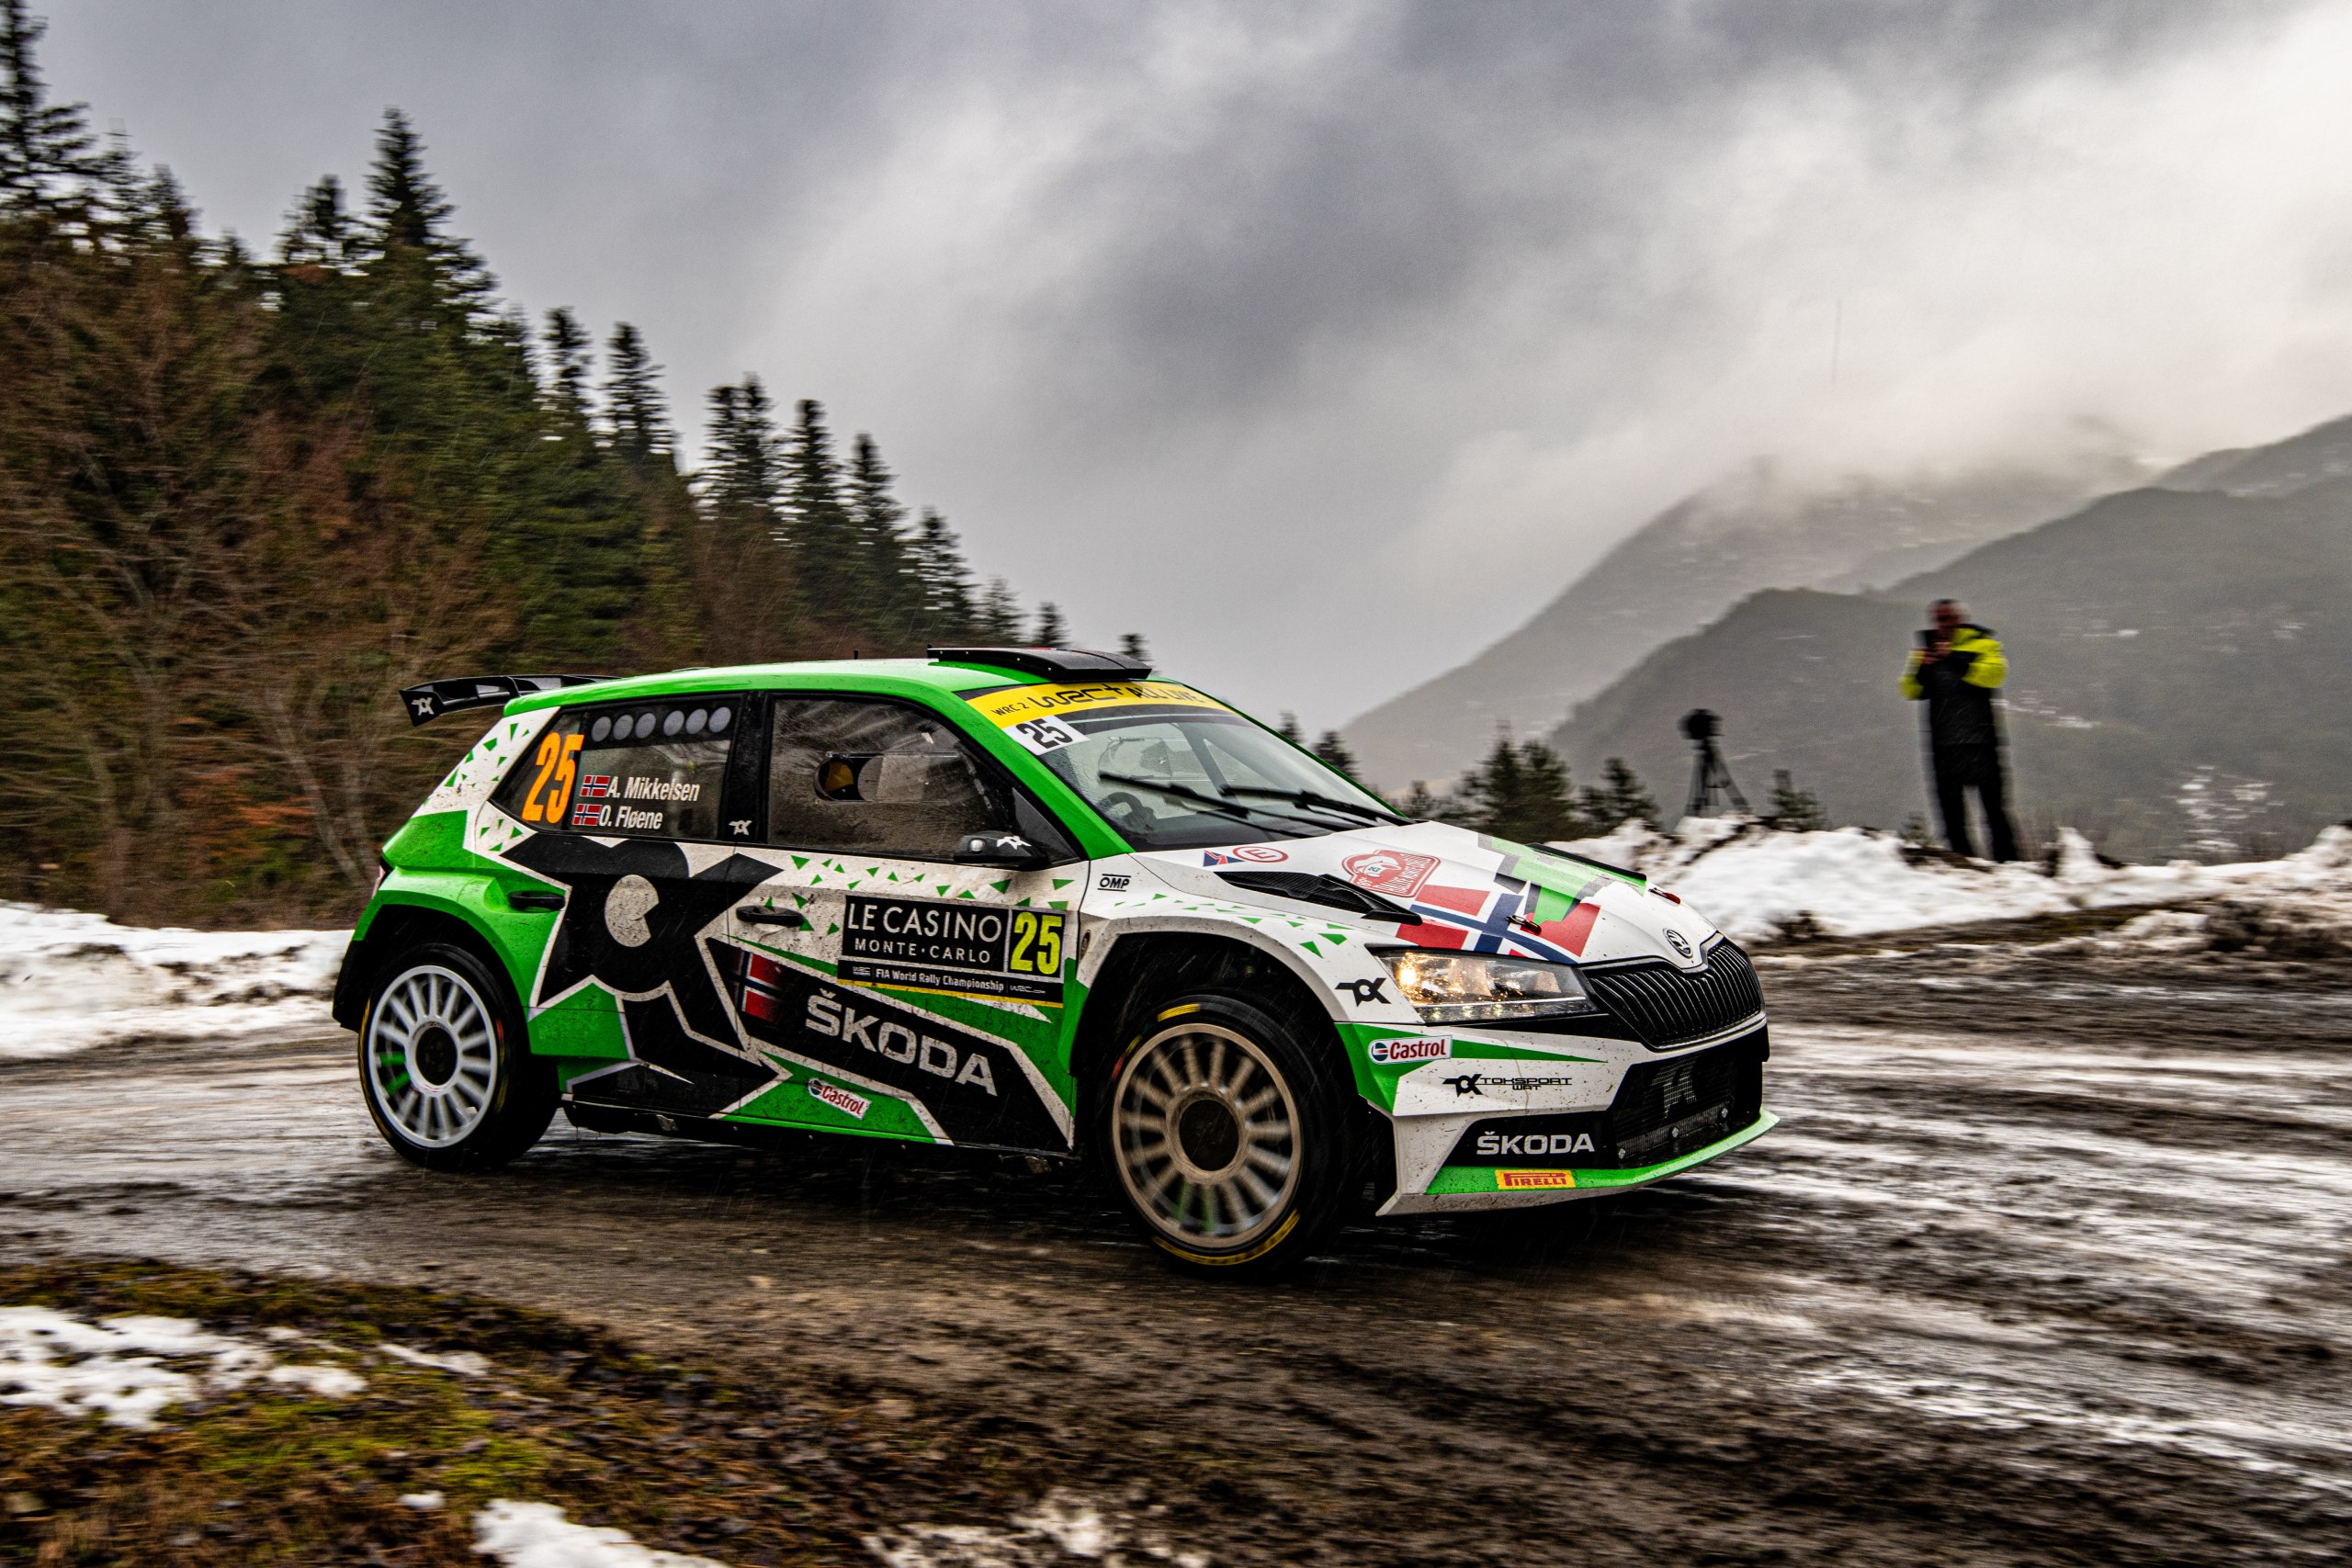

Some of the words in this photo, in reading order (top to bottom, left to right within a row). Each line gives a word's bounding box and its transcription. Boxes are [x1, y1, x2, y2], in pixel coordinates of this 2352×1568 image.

[992, 705, 1020, 716] WRC
[1015, 717, 1074, 750] 25
[521, 731, 585, 824] 25
[606, 775, 621, 797] A.
[625, 776, 701, 802] Mikkelsen
[598, 804, 613, 827] O.
[615, 806, 663, 829] Fløene
[1100, 876, 1130, 889] OMP
[847, 903, 877, 931] LE
[882, 907, 1002, 942] CASINO
[1011, 911, 1063, 975] 25
[876, 968, 890, 979] FIA
[891, 969, 917, 982] World
[919, 973, 942, 986] Rally
[943, 975, 1004, 993] Championship
[805, 987, 999, 1097] ŠKODA
[1389, 1039, 1446, 1060] Castrol
[821, 1085, 864, 1115] Castrol
[1476, 1131, 1595, 1156] ŠKODA
[1503, 1172, 1566, 1187] PIRELLI
